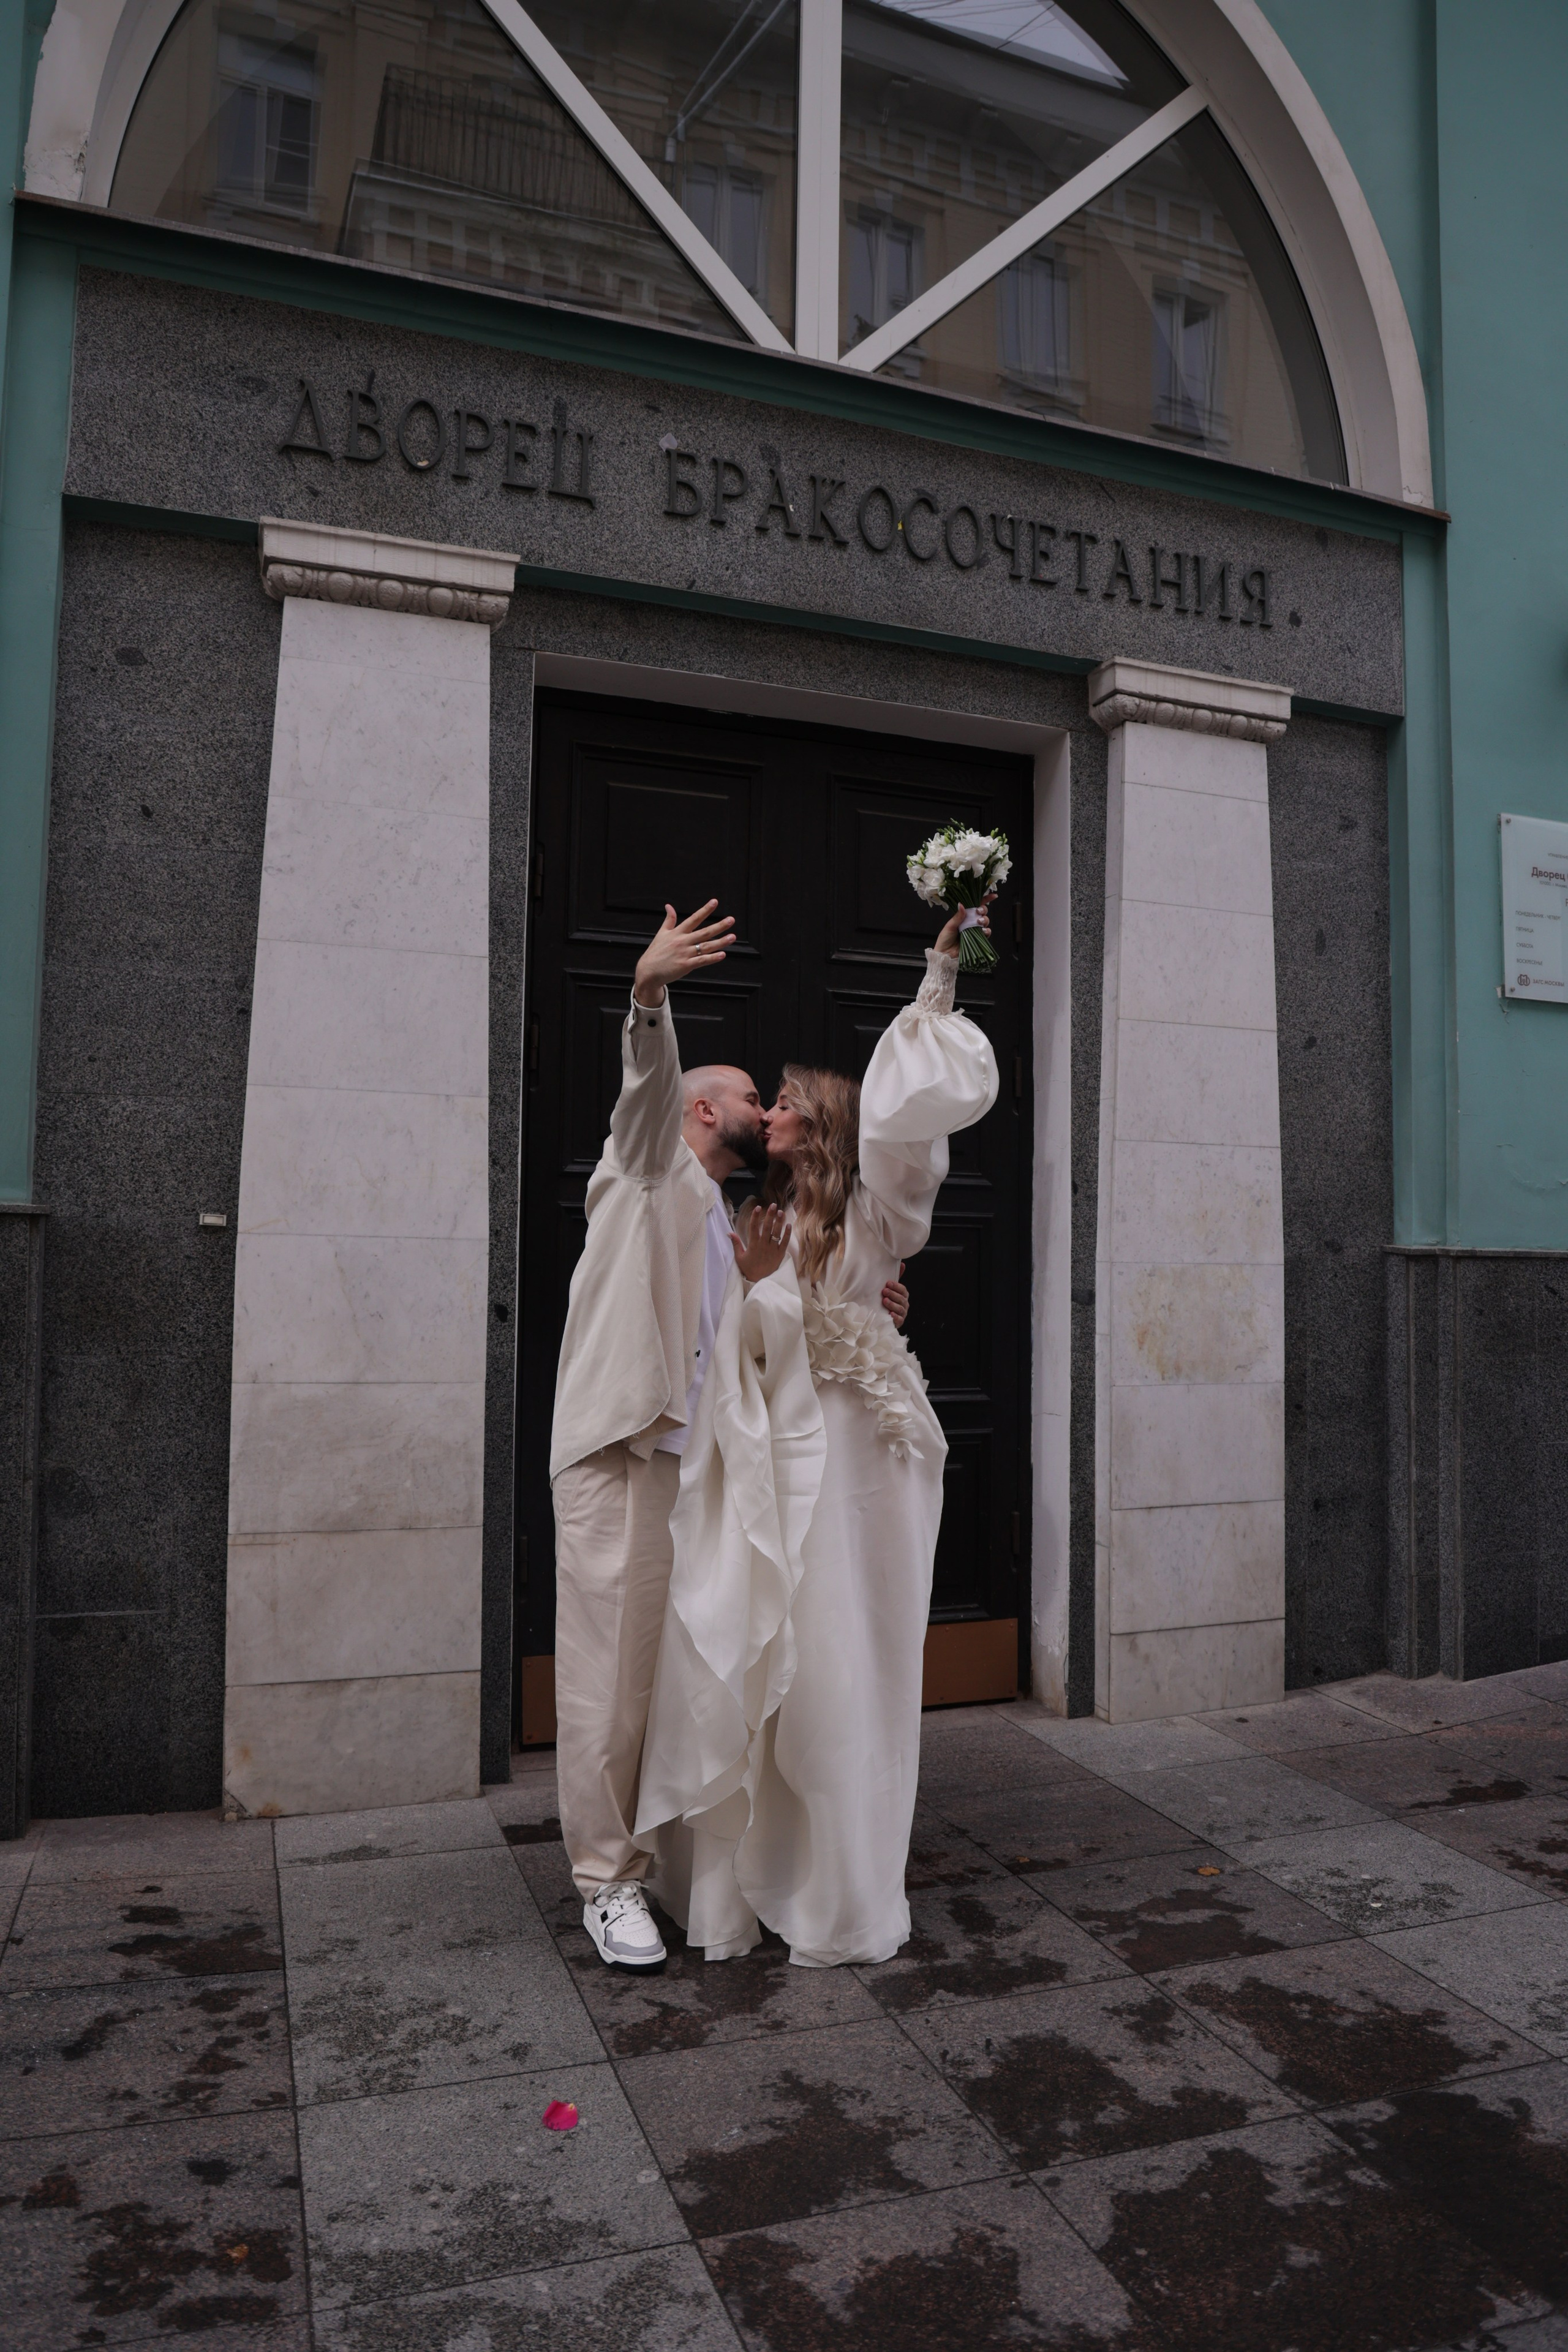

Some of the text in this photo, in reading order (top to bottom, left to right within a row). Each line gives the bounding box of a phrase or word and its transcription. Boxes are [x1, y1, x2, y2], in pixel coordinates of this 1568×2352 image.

[279, 377, 1274, 629] ДВОРЕЦ БРАКОСОЧЕТАНИЯ
[1531, 866, 1566, 882] Дворец
